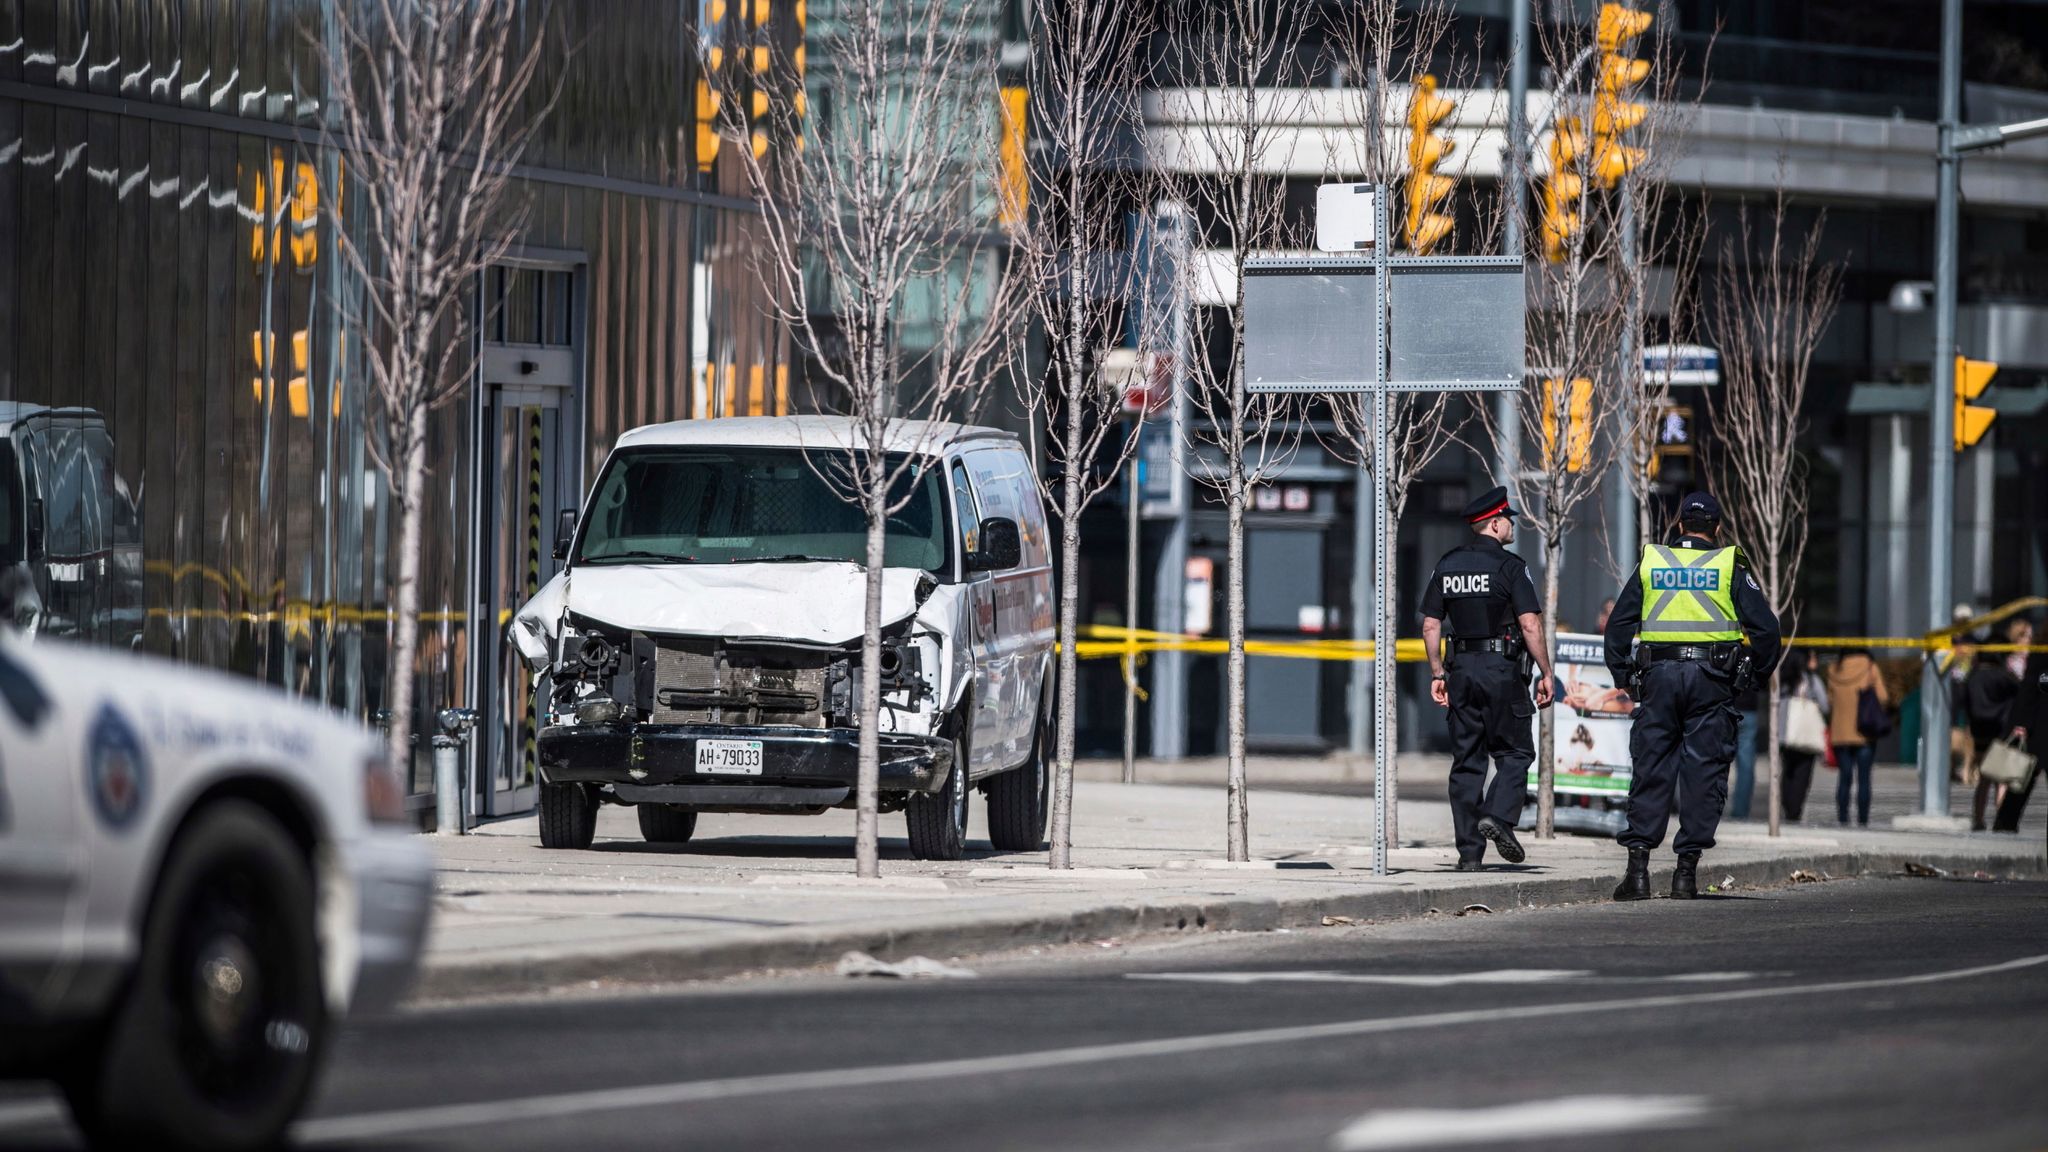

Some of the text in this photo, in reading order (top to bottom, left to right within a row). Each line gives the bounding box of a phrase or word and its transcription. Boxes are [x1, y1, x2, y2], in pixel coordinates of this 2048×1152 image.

[1443, 574, 1490, 594] POLICE
[1652, 570, 1718, 588] POLICE
[1557, 644, 1594, 656] JESSE'S
[699, 749, 760, 766] AH 79033
